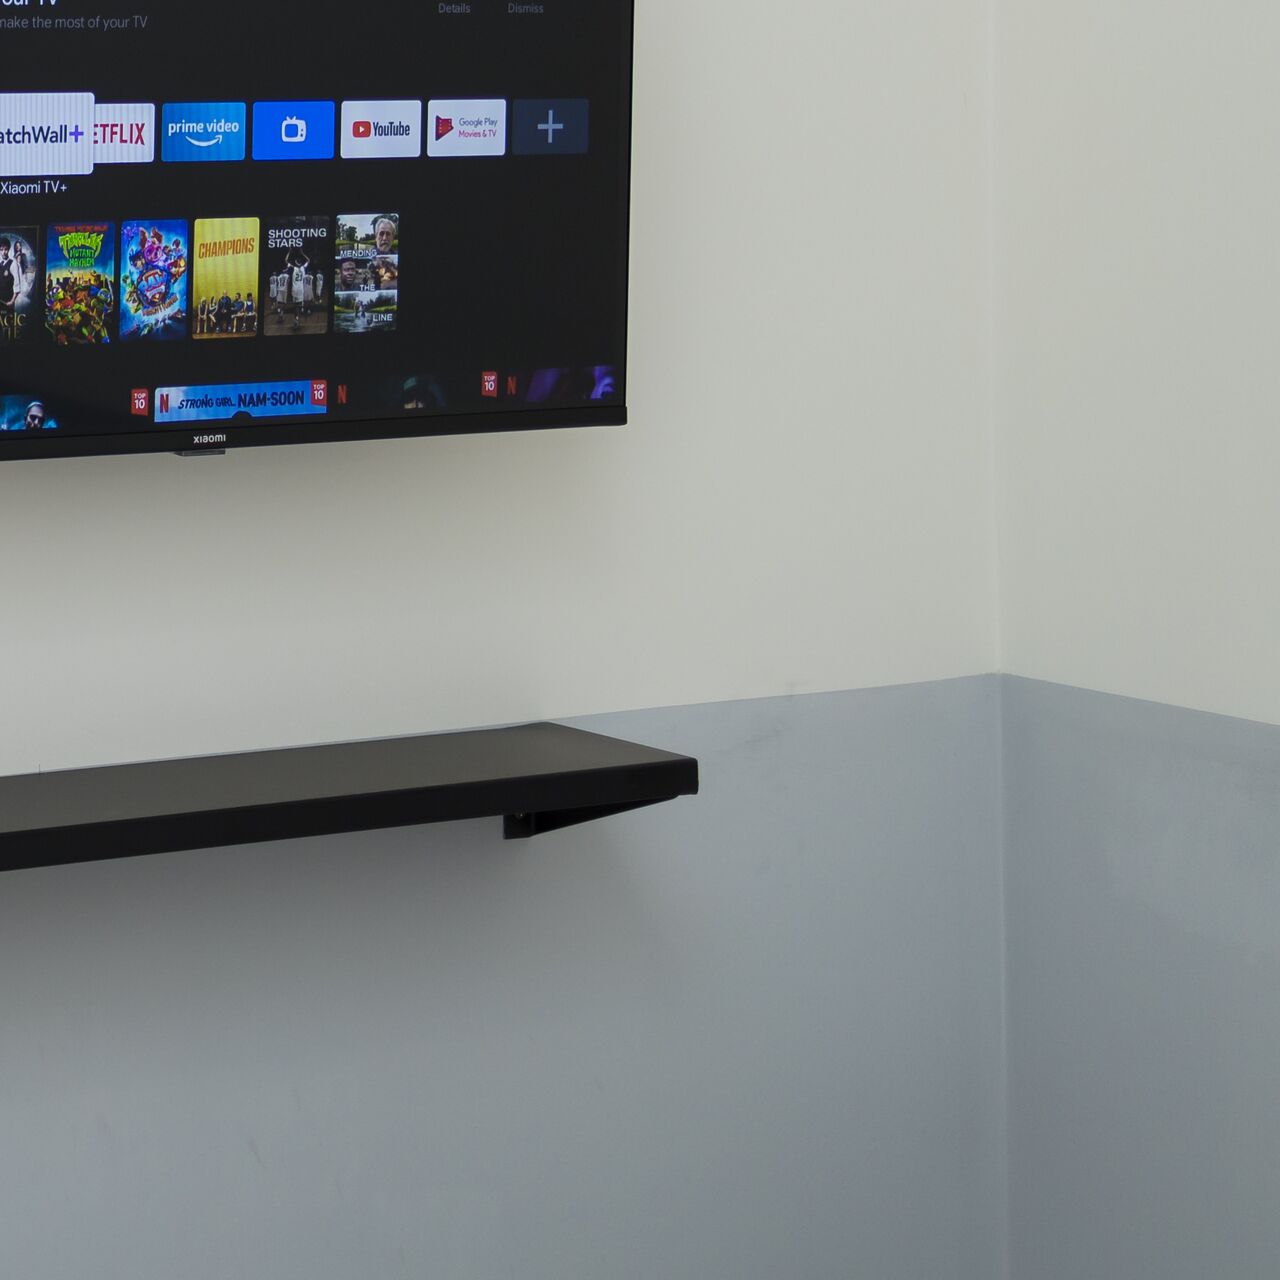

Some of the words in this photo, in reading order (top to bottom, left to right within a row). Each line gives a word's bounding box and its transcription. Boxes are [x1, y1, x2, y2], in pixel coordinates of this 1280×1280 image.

[438, 2, 471, 14] Details
[507, 2, 544, 14] Dismiss
[32, 15, 52, 29] the
[55, 16, 85, 29] most
[87, 15, 101, 29] of
[103, 17, 130, 32] your
[132, 15, 148, 29] TV
[168, 122, 204, 138] prime
[206, 119, 239, 134] video
[372, 122, 411, 137] YouTube
[458, 117, 482, 130] Google
[483, 117, 498, 128] Play
[458, 129, 481, 139] Movies
[487, 129, 497, 138] TV
[0, 180, 40, 195] Xiaomi
[43, 181, 68, 194] TV+
[268, 228, 327, 239] SHOOTING
[198, 237, 255, 259] CHAMPIONS
[268, 238, 303, 248] STARS
[339, 249, 378, 257] MENDING
[372, 313, 393, 322] LINE
[484, 381, 495, 391] 10
[178, 396, 215, 411] STRONG
[216, 396, 236, 407] GIRL
[237, 390, 305, 408] NAM-SOON
[313, 390, 325, 400] 10
[134, 399, 146, 409] 10
[158, 392, 169, 413] N
